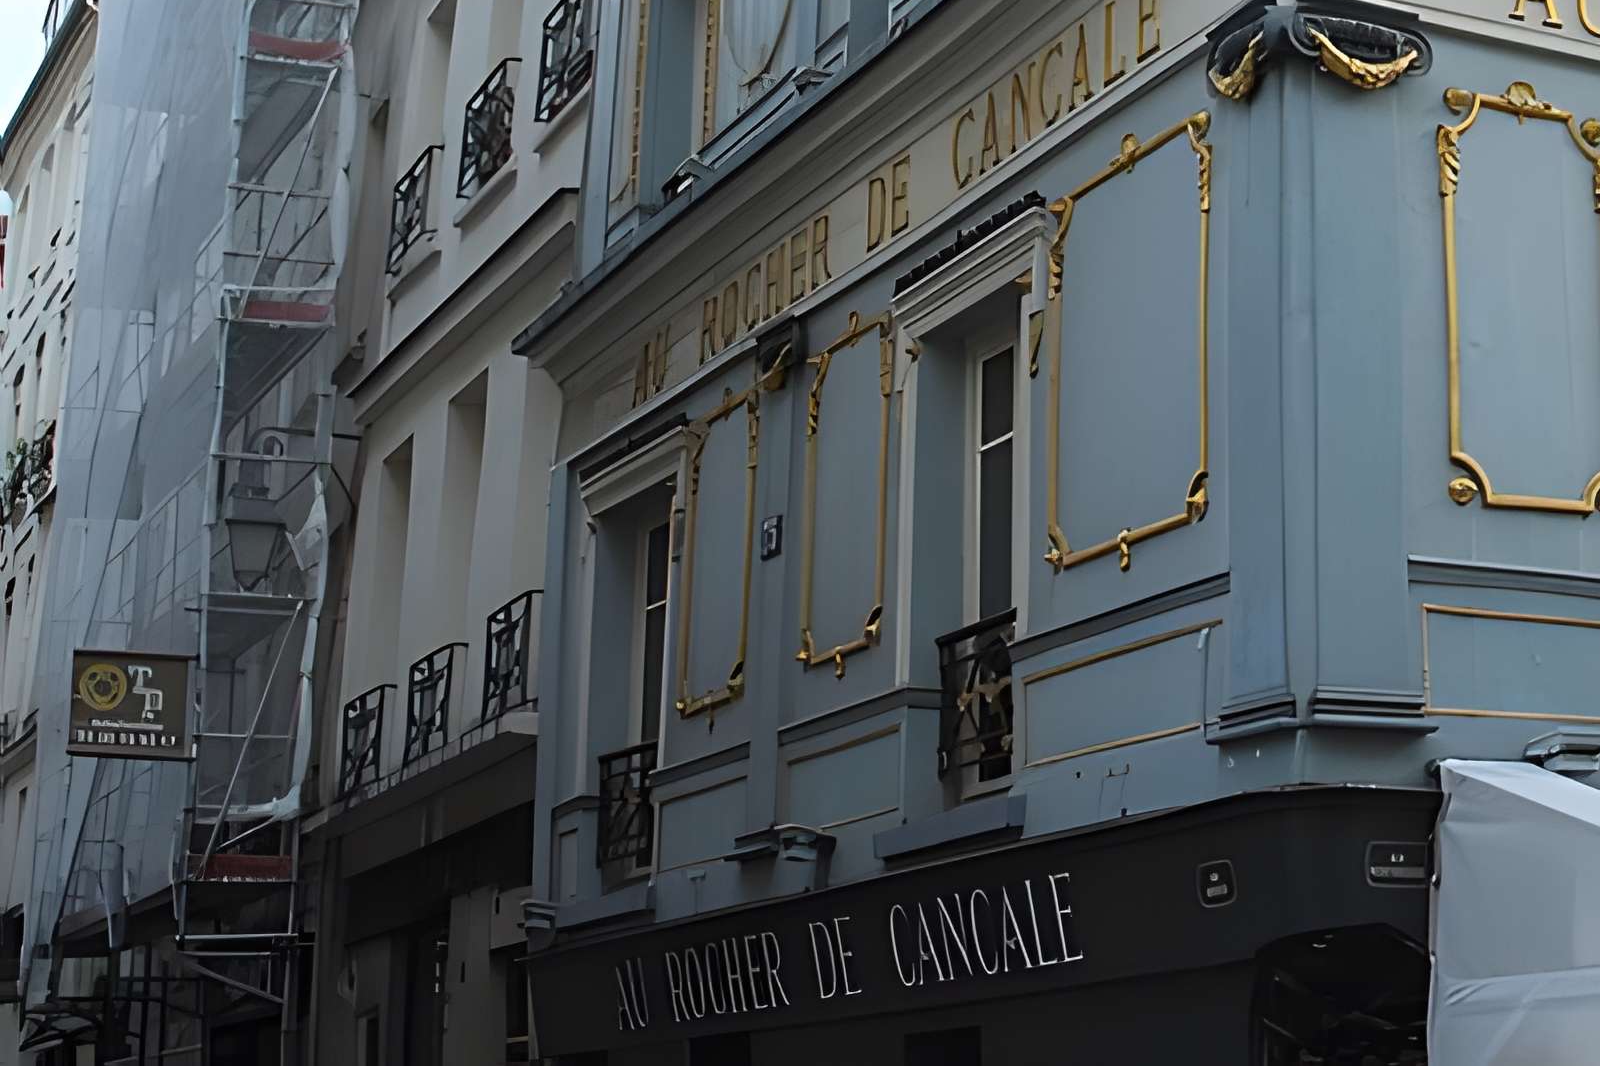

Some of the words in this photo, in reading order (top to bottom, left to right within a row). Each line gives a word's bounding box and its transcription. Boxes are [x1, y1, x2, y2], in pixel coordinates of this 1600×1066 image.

[866, 154, 911, 253] DE
[615, 957, 649, 1030] AU
[665, 932, 790, 1022] ROCHER
[809, 916, 862, 999] DE
[889, 872, 1084, 986] CANCALE
